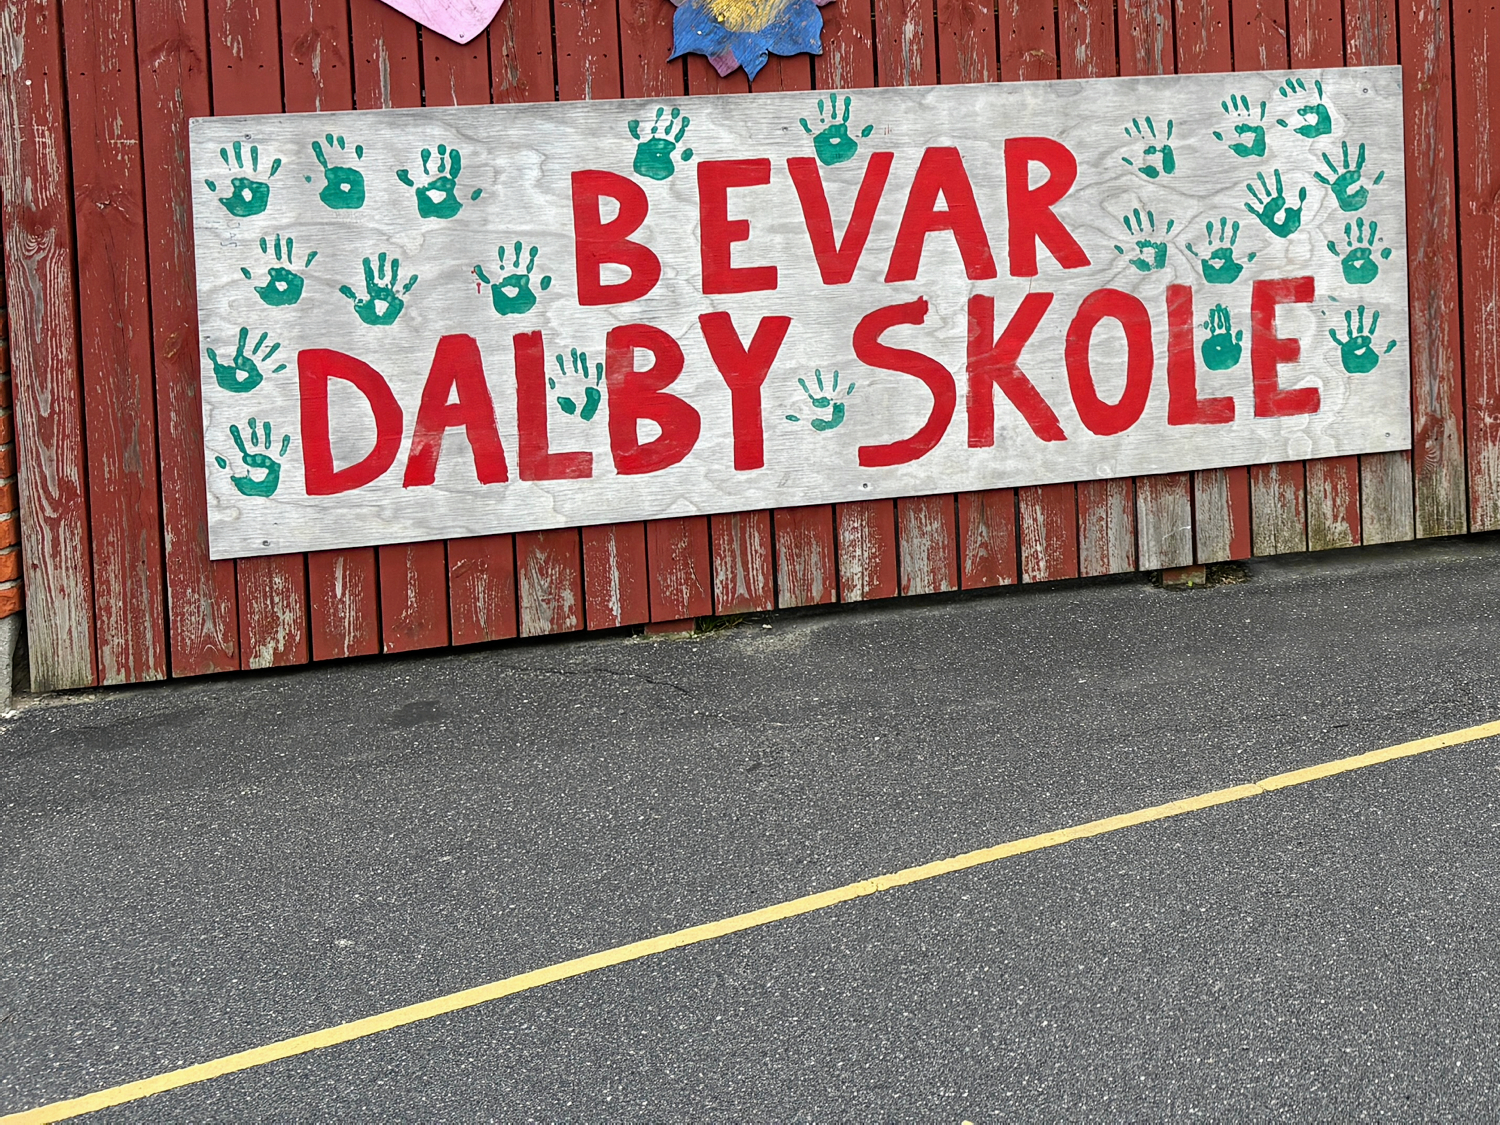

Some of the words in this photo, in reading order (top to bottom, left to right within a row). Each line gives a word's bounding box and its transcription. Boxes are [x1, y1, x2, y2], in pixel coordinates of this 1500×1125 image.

[571, 137, 1091, 306] BEVAR
[298, 312, 792, 495] DALBY
[853, 277, 1320, 467] SKOLE
